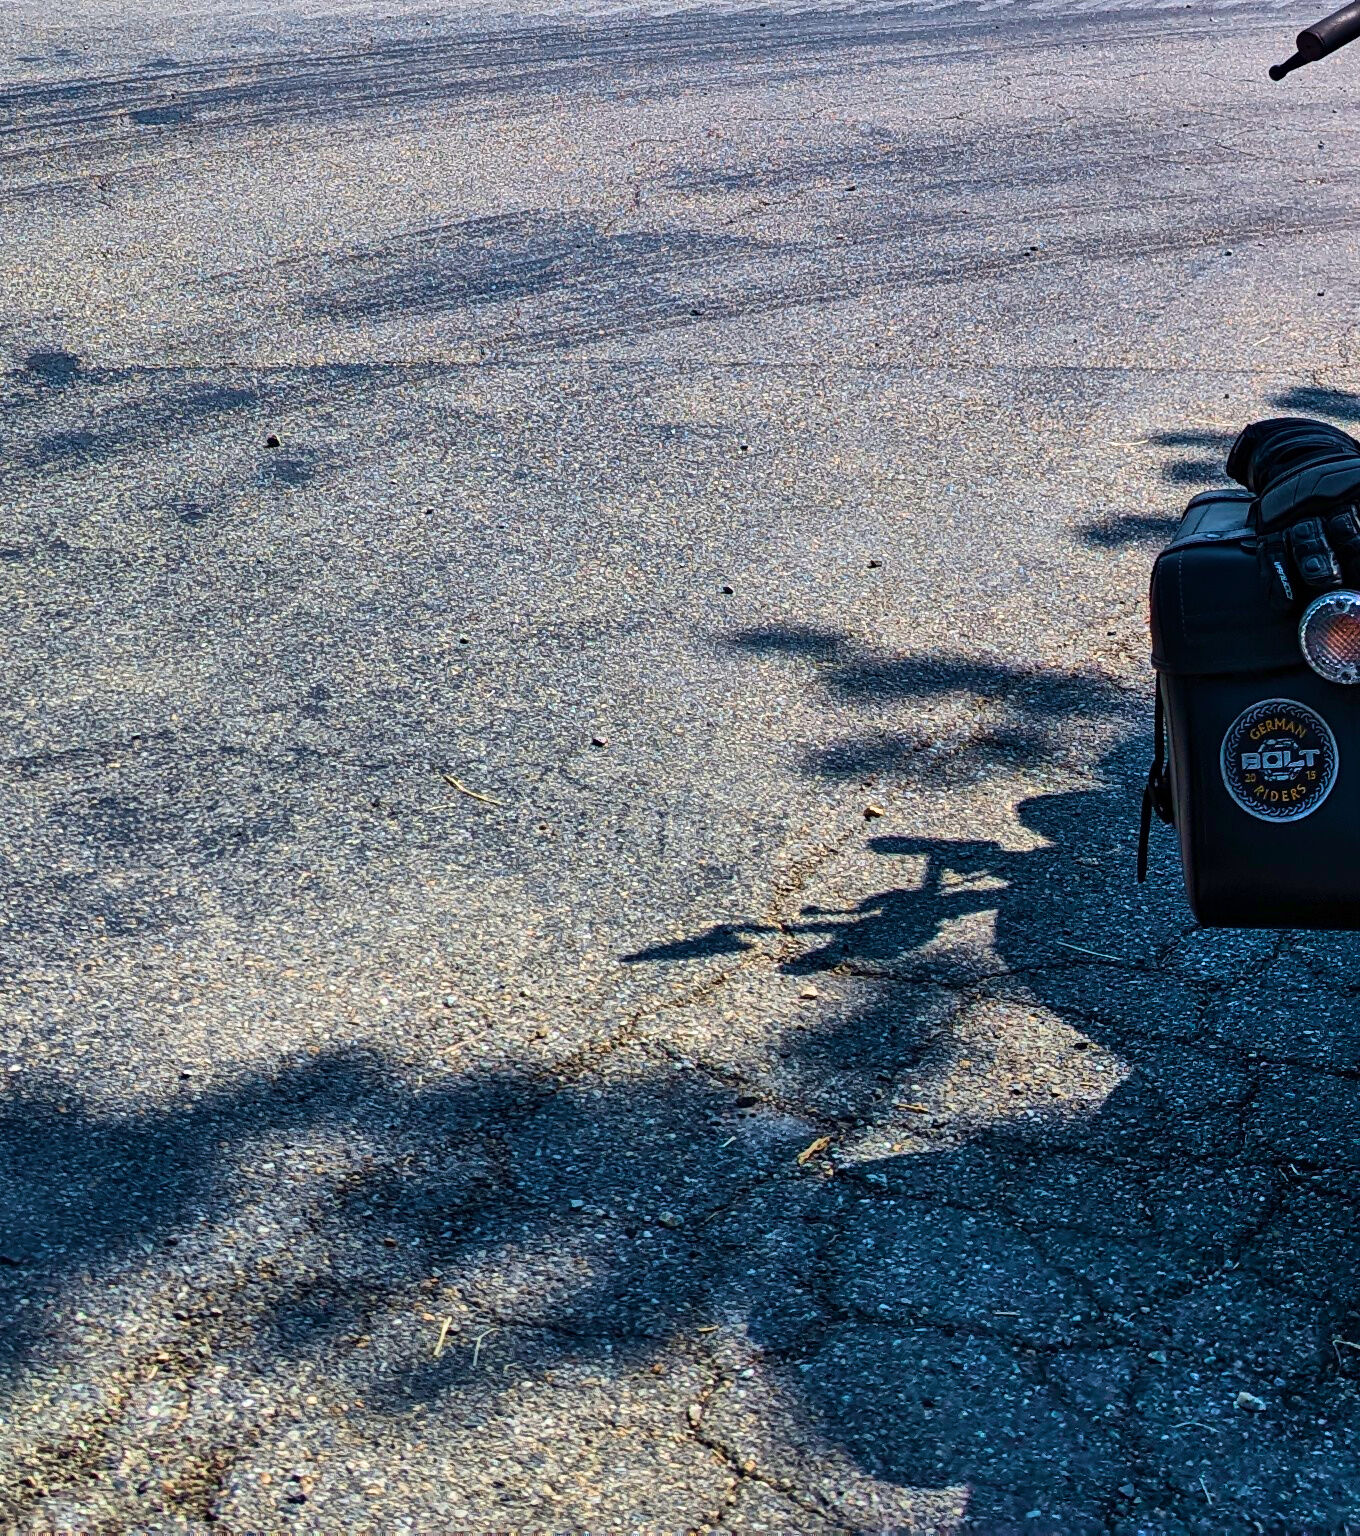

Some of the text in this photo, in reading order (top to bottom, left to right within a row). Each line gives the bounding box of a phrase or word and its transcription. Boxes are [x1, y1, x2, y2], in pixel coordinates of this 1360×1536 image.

[1249, 717, 1308, 740] GERMAN
[1241, 748, 1320, 770] BOLT
[1244, 772, 1256, 783] 20
[1253, 783, 1307, 802] RIDERS
